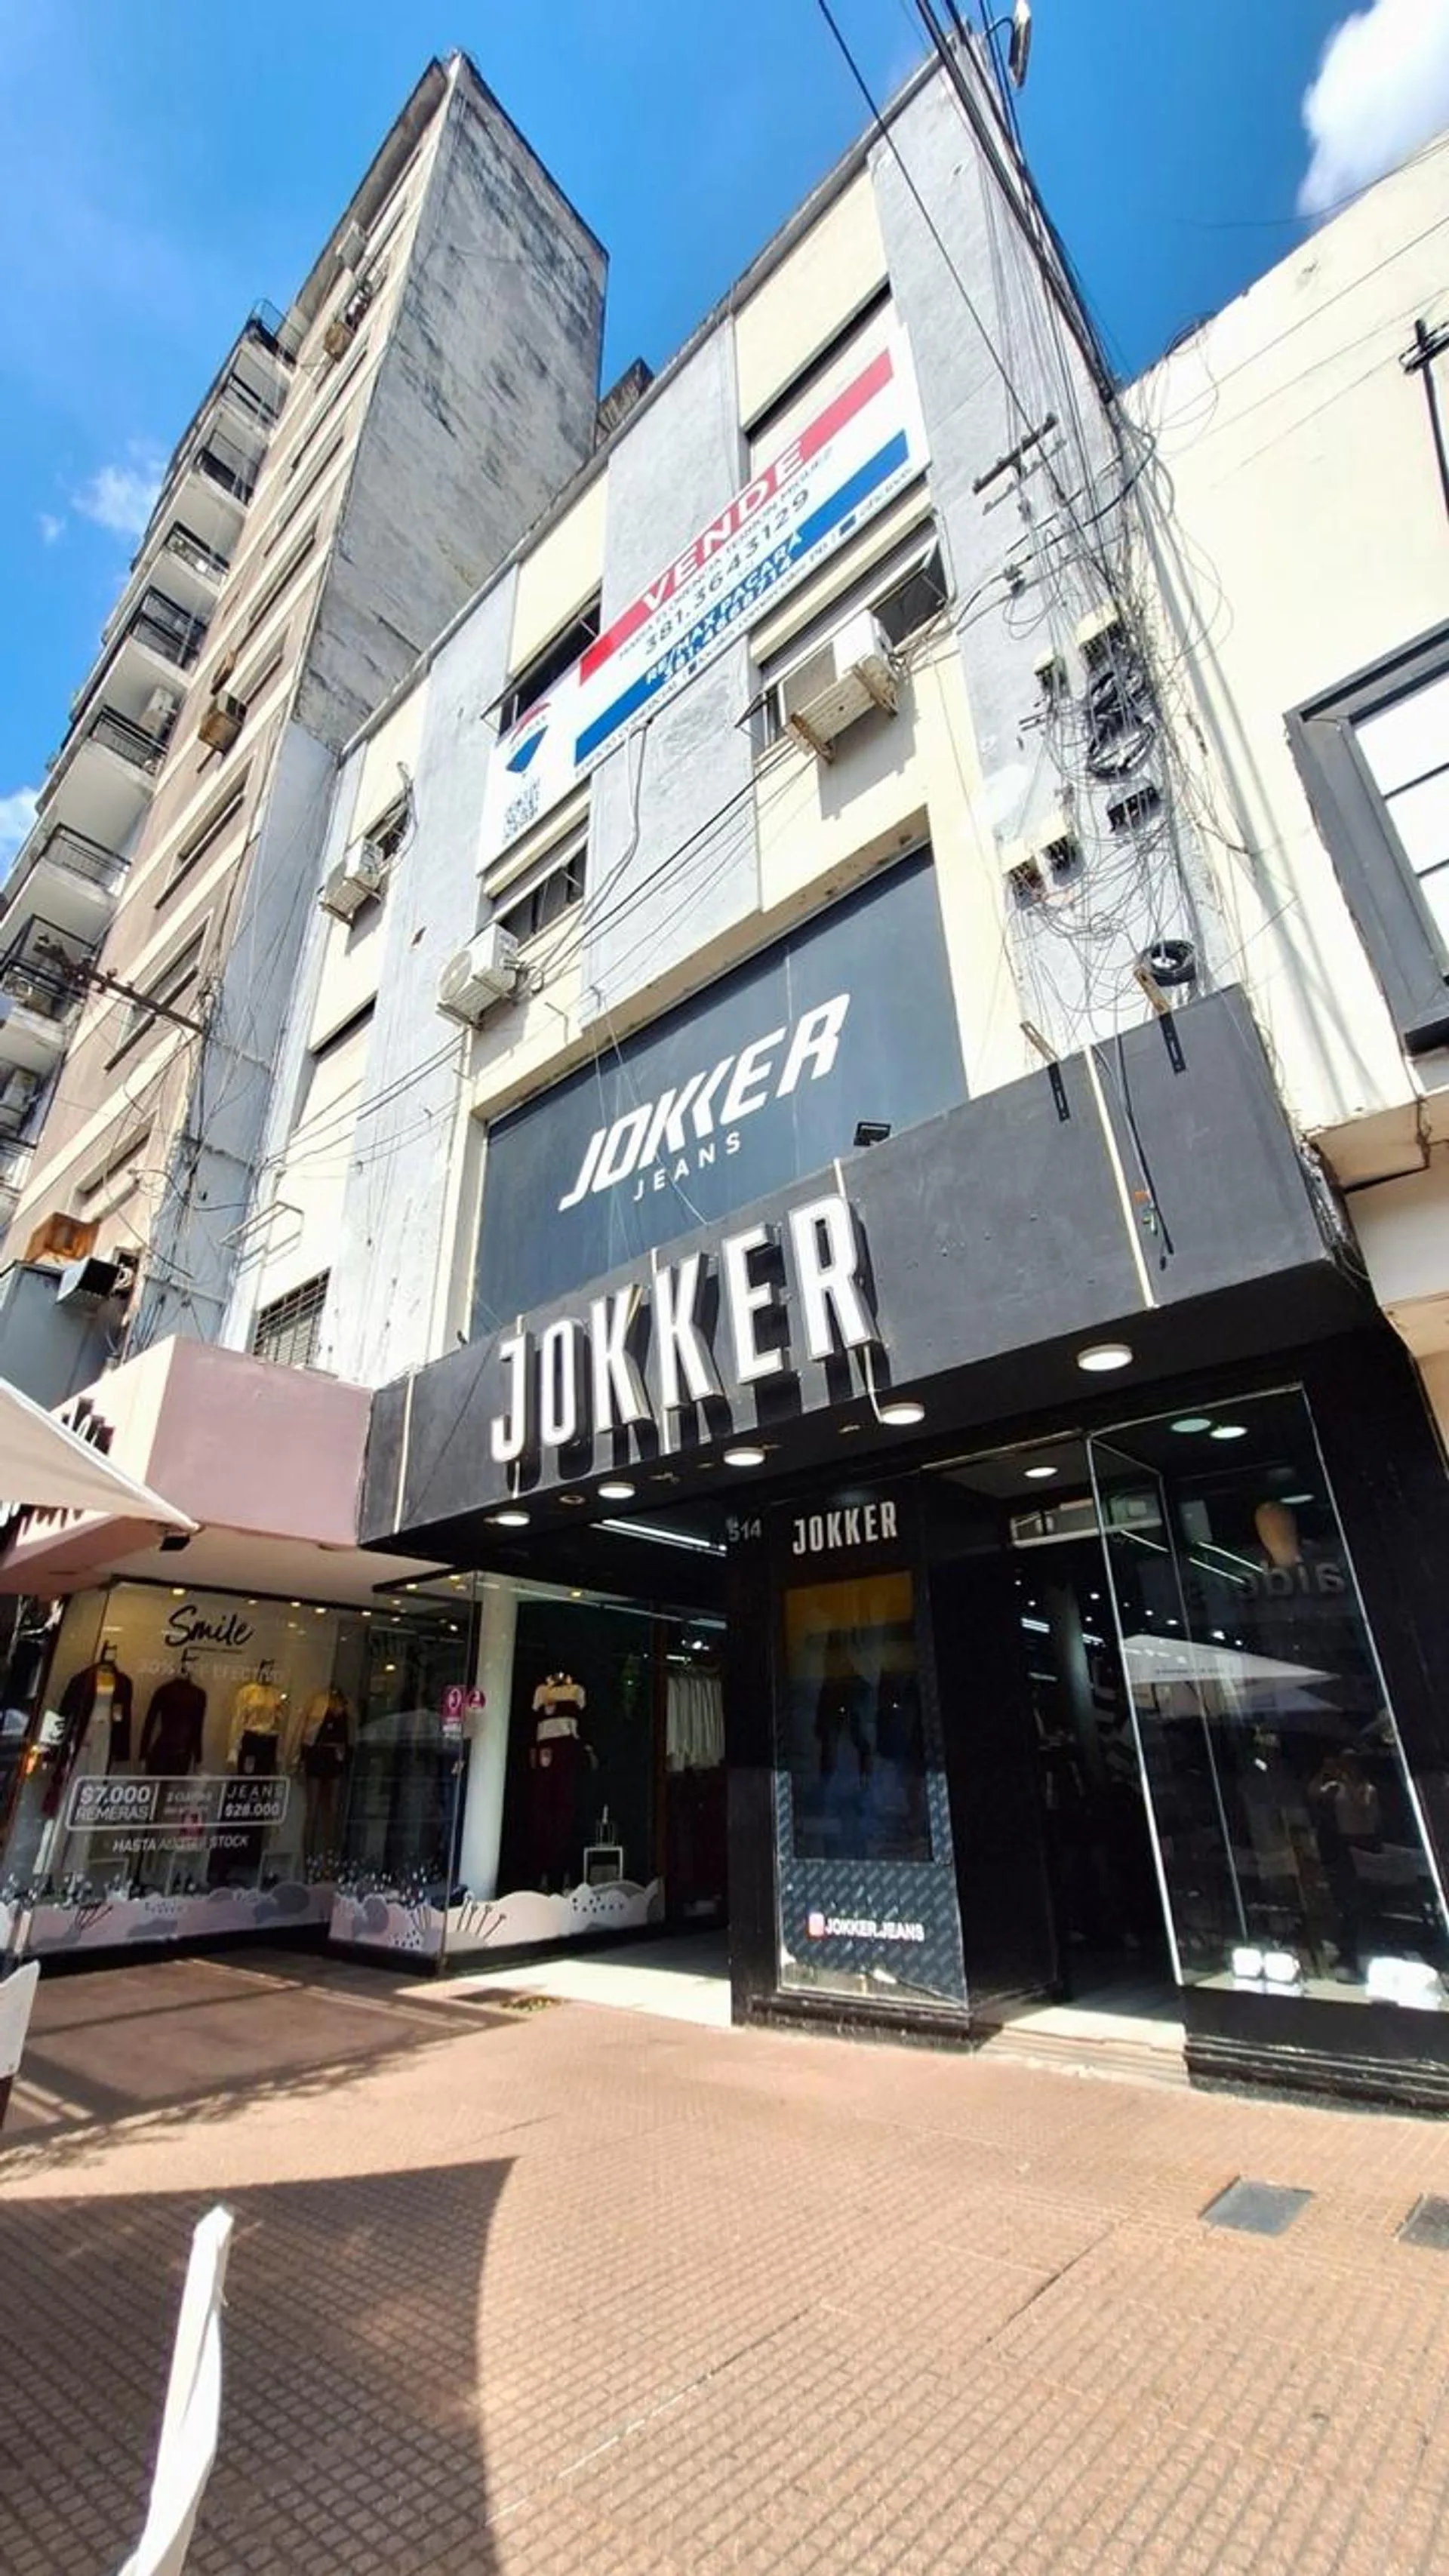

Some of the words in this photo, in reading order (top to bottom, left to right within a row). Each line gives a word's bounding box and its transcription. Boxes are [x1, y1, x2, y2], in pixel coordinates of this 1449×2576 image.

[641, 440, 805, 612] VENDE
[645, 488, 808, 655] 381.3643129
[558, 993, 851, 1211] JOKKER
[633, 1131, 741, 1202] JEANS
[491, 1193, 881, 1463] JOKKER
[793, 1500, 897, 1555] JOKKER
[165, 1605, 254, 1647] Smile
[75, 1805, 149, 1821] REMERAS
[228, 1784, 285, 1799] JEANS
[113, 1837, 156, 1853] HASTA
[209, 1835, 250, 1848] STOCK
[824, 1917, 924, 1943] JOKKER.JEANS
